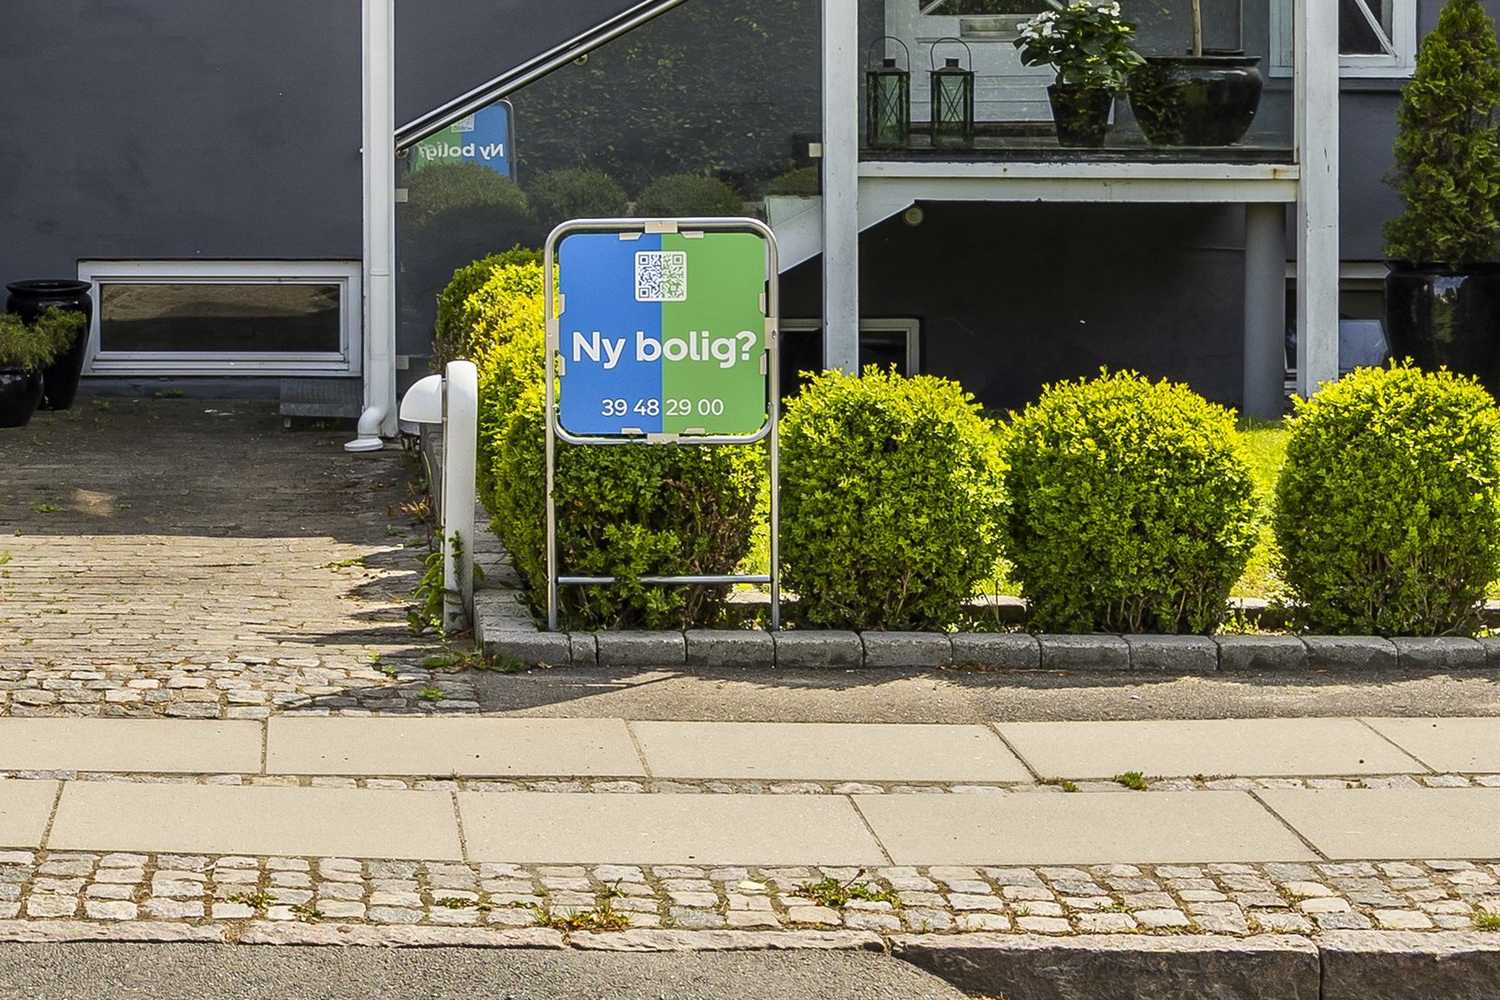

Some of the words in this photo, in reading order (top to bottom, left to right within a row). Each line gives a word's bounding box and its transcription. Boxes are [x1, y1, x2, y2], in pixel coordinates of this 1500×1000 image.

[572, 331, 626, 369] Ny
[636, 330, 757, 369] bolig?
[601, 398, 628, 416] 39
[633, 398, 660, 416] 48
[666, 398, 692, 416] 29
[698, 398, 724, 416] 00
